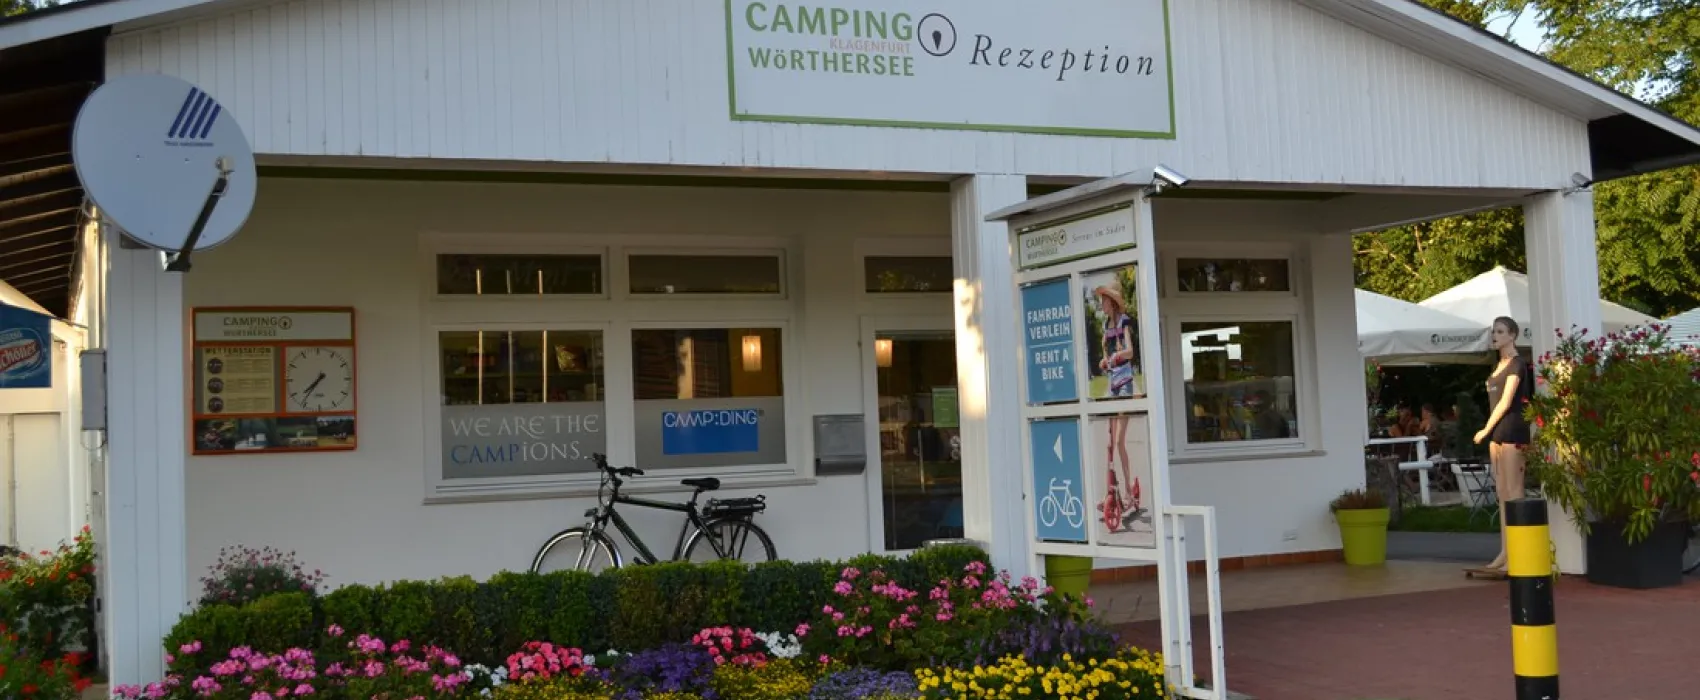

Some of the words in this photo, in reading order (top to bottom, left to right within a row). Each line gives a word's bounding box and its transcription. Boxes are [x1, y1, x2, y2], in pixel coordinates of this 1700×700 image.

[745, 2, 912, 41] CAMPING
[829, 38, 910, 54] KLAGENFURT
[969, 34, 1153, 81] Rezeption
[1026, 231, 1058, 249] CAMPING
[223, 316, 278, 327] CAMPING
[1027, 304, 1070, 324] FAHRRAD
[1029, 322, 1070, 340] VERLEIH
[1035, 350, 1060, 365] RENT
[1063, 349, 1069, 361] A
[1041, 366, 1064, 380] BIKE
[449, 417, 491, 437] WE
[498, 416, 546, 440] ARE
[551, 414, 599, 434] THE
